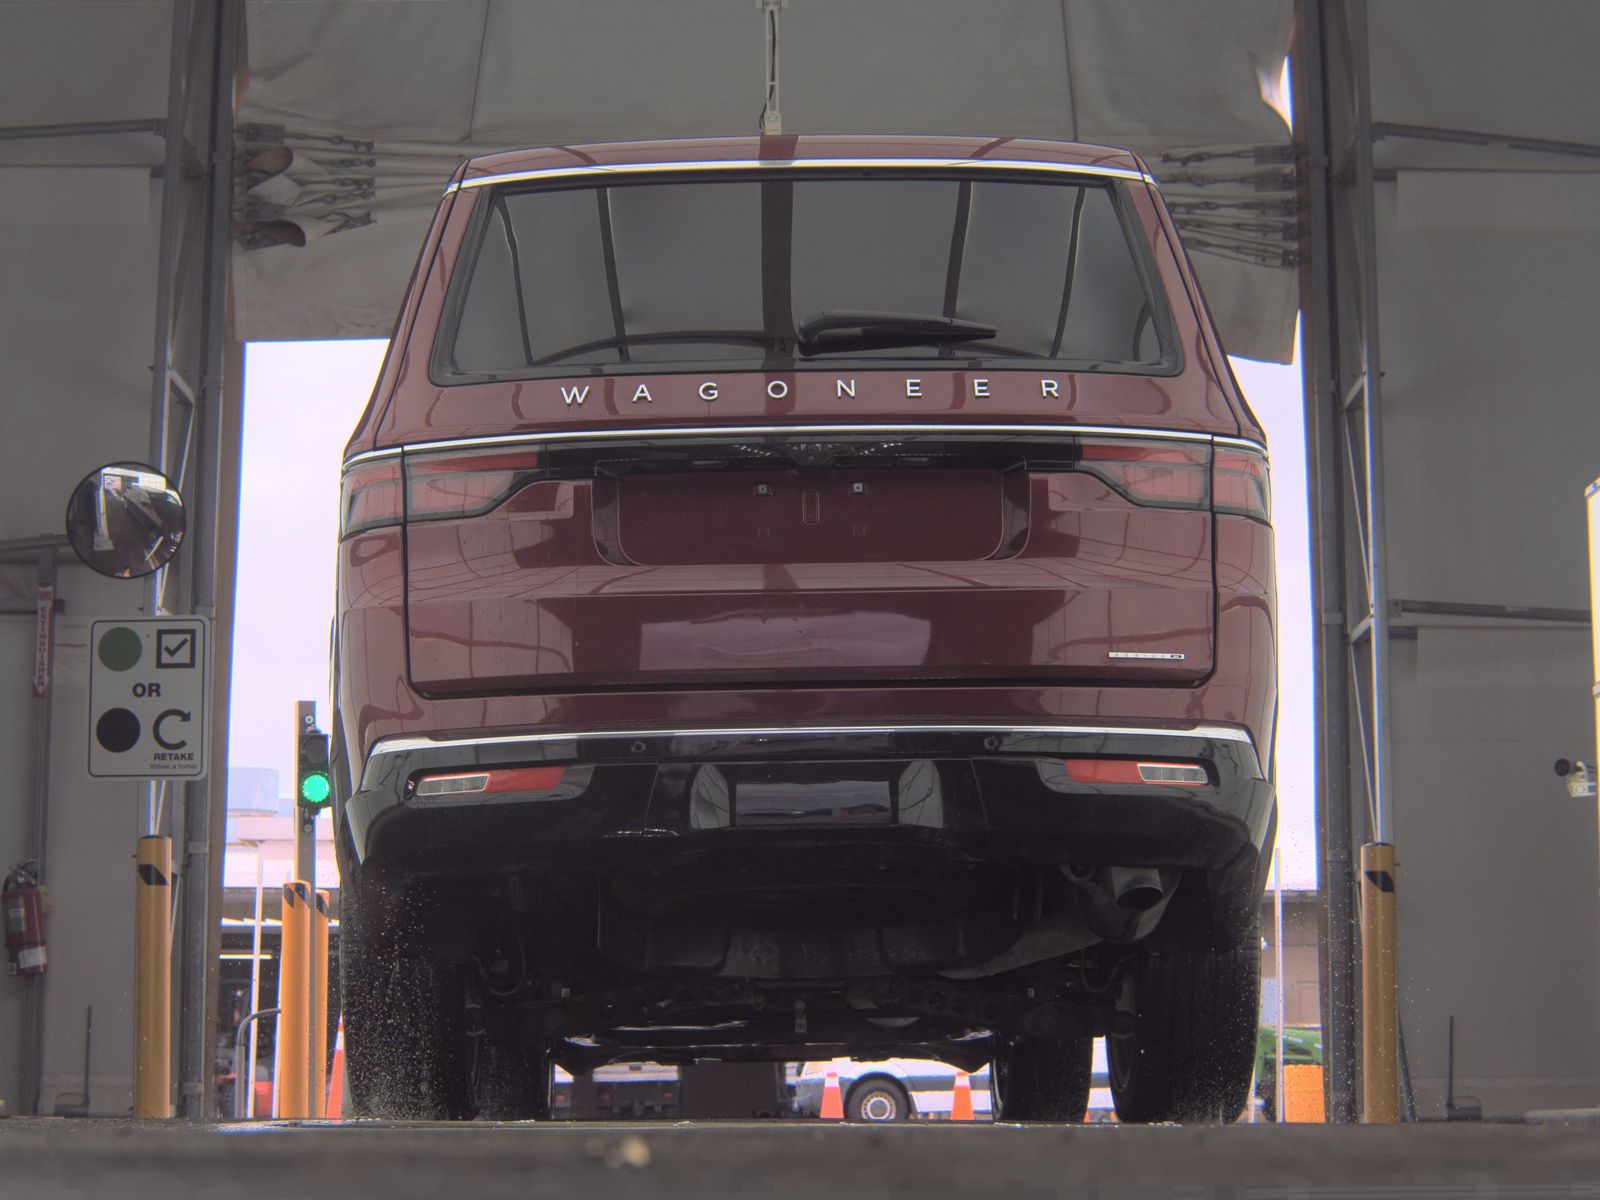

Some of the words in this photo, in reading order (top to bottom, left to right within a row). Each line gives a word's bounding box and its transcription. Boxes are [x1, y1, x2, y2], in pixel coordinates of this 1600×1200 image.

[561, 379, 1059, 404] WAGONEER
[132, 683, 161, 697] OR
[153, 752, 195, 761] RETAKE
